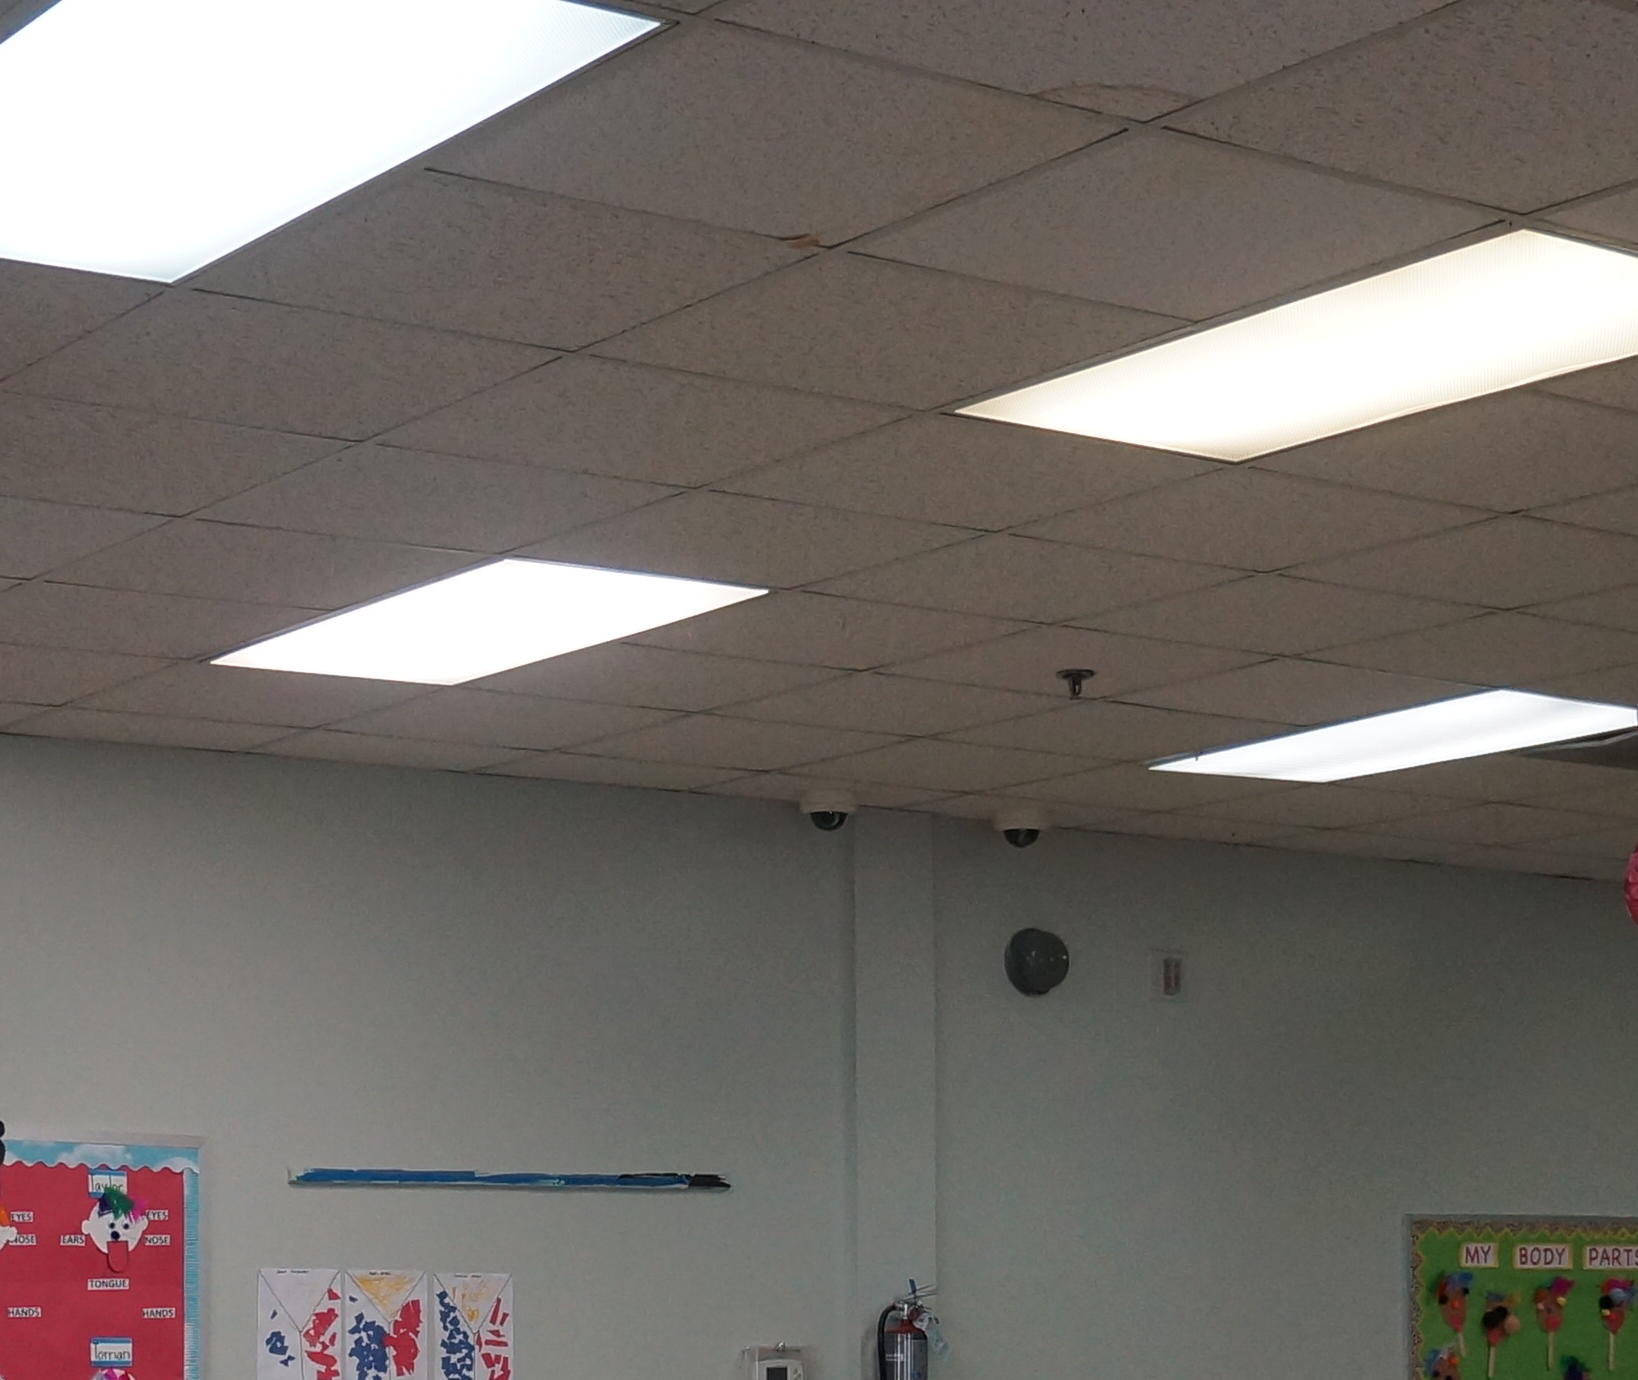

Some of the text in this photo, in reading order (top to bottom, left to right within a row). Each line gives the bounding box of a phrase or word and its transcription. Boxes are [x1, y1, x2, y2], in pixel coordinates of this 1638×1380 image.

[1465, 1245, 1491, 1264] MY
[1518, 1247, 1567, 1265] BODY
[89, 1279, 128, 1288] TONGUE
[8, 1308, 40, 1317] HANDS
